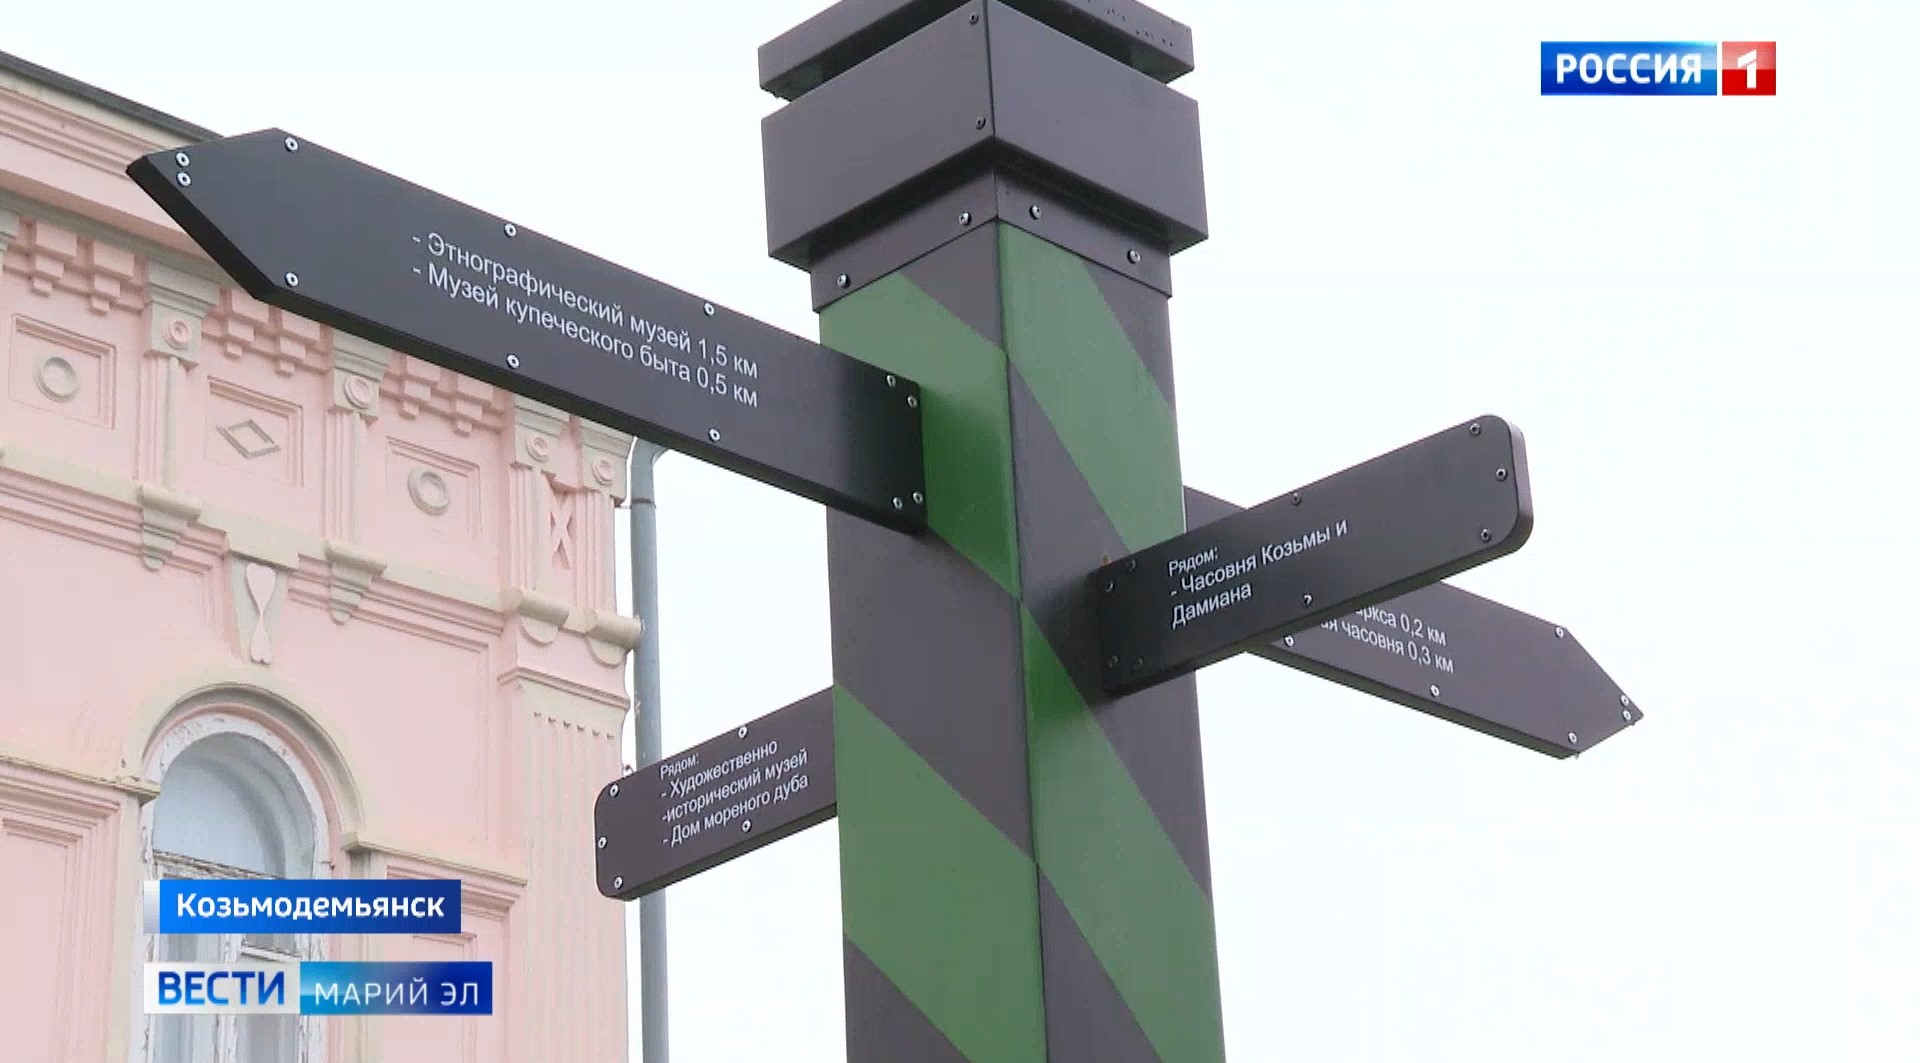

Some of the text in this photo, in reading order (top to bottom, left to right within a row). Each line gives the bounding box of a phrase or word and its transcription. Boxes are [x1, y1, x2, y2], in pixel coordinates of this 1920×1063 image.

[428, 232, 624, 327] Этнографический
[631, 315, 691, 353] музей
[699, 338, 728, 366] 1,5
[734, 355, 758, 379] км
[429, 262, 499, 310] Музей
[506, 297, 633, 360] купеческого
[640, 345, 690, 382] быта
[697, 366, 728, 395] 0,5
[734, 384, 758, 408] км
[1168, 546, 1220, 577] Рядом:
[1181, 554, 1257, 594] Часовня
[1261, 526, 1331, 566] Козьмы
[1336, 519, 1348, 537] и
[1172, 583, 1252, 630] Дамиана
[1356, 606, 1397, 629] ркса
[1400, 613, 1425, 638] 0,2
[1427, 626, 1447, 647] км
[1341, 620, 1405, 657] часовня
[1407, 641, 1432, 666] 0,3
[1435, 654, 1455, 674] км
[660, 752, 700, 781] Рядом:
[662, 748, 808, 823] -исторический музей
[669, 740, 778, 799] Художественно
[671, 819, 700, 848] Дом
[704, 792, 770, 831] мореного
[774, 774, 809, 804] дуба
